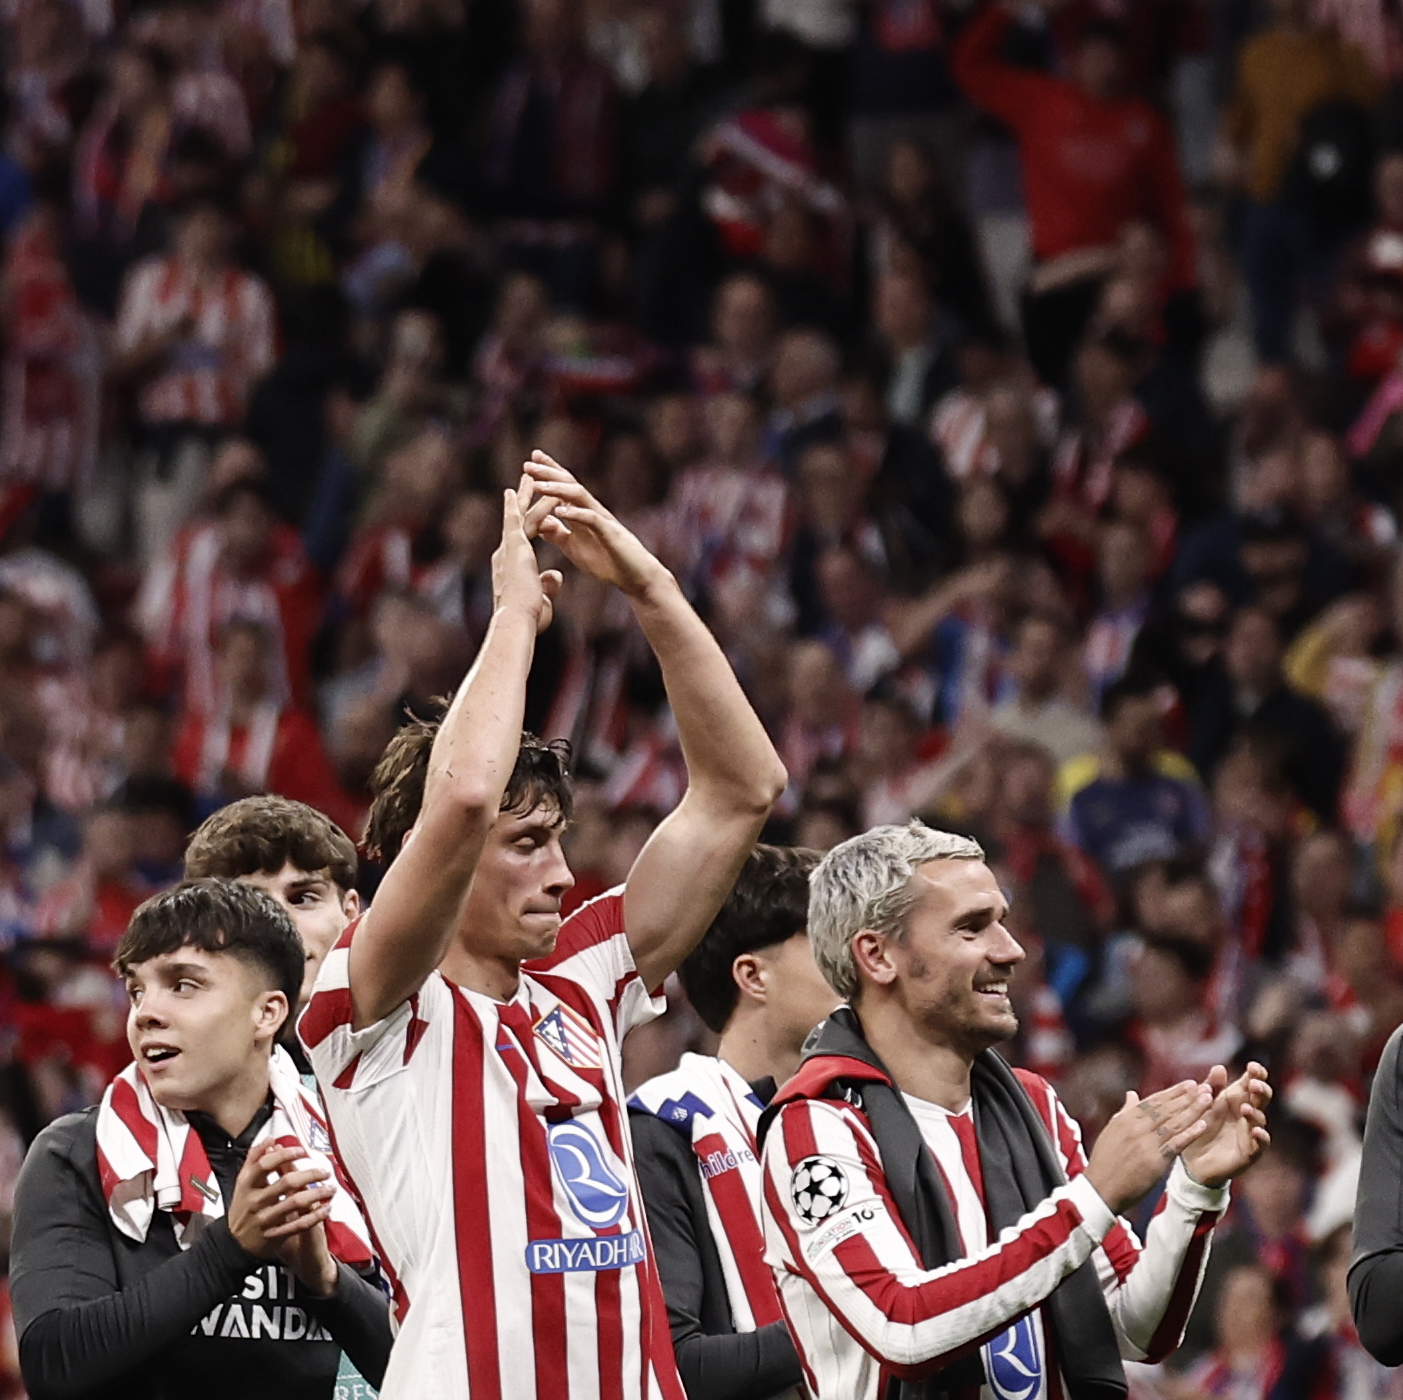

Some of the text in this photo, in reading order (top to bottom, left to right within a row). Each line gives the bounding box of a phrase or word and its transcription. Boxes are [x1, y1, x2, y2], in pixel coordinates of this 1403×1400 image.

[699, 1149, 755, 1179] hildre
[534, 1238, 627, 1270] RIYADH
[242, 1265, 296, 1300] SIT
[190, 1303, 333, 1341] WANDA
